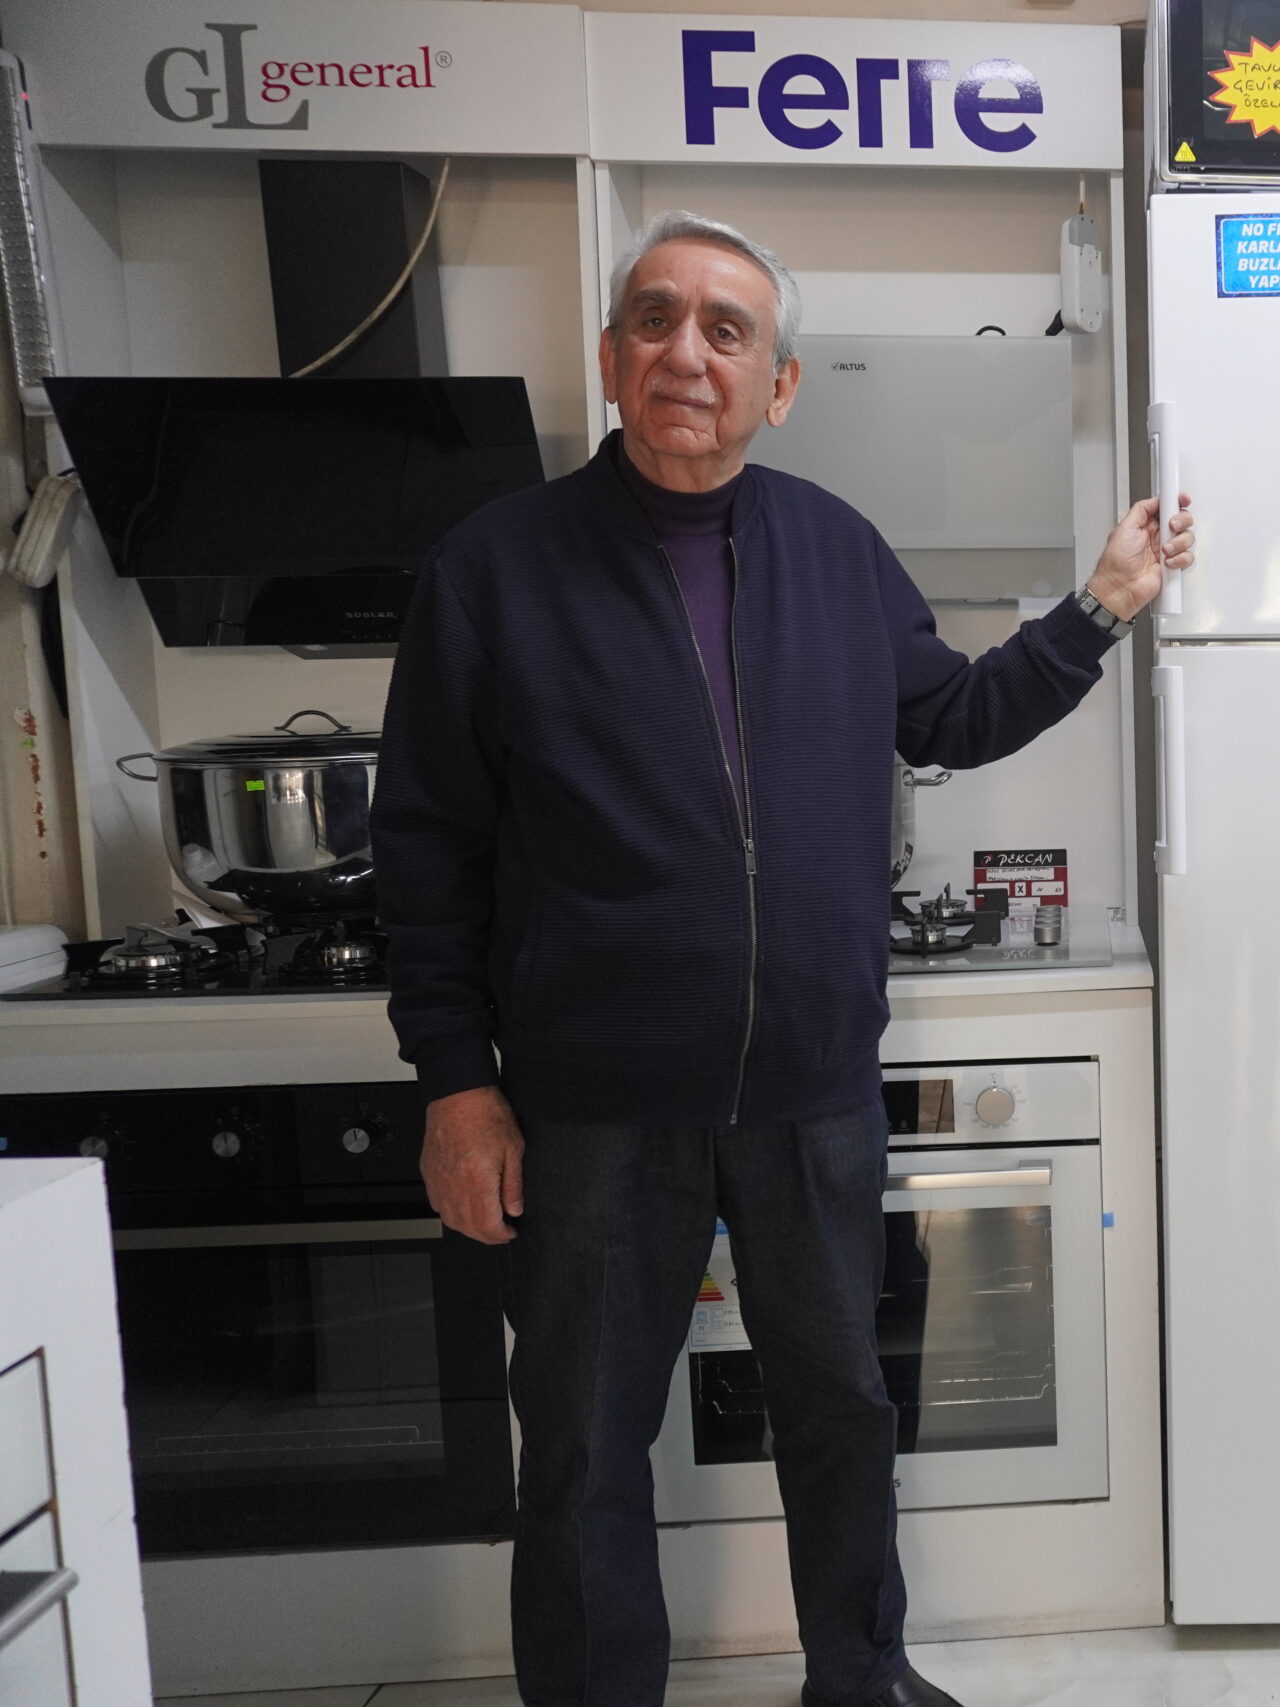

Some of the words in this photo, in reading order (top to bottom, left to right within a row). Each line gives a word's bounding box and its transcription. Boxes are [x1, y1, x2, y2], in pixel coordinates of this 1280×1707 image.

[145, 23, 309, 131] GL
[682, 30, 1043, 153] Ferre
[1241, 223, 1264, 236] NO
[998, 853, 1053, 866] PEKCAN
[1017, 885, 1024, 893] X
